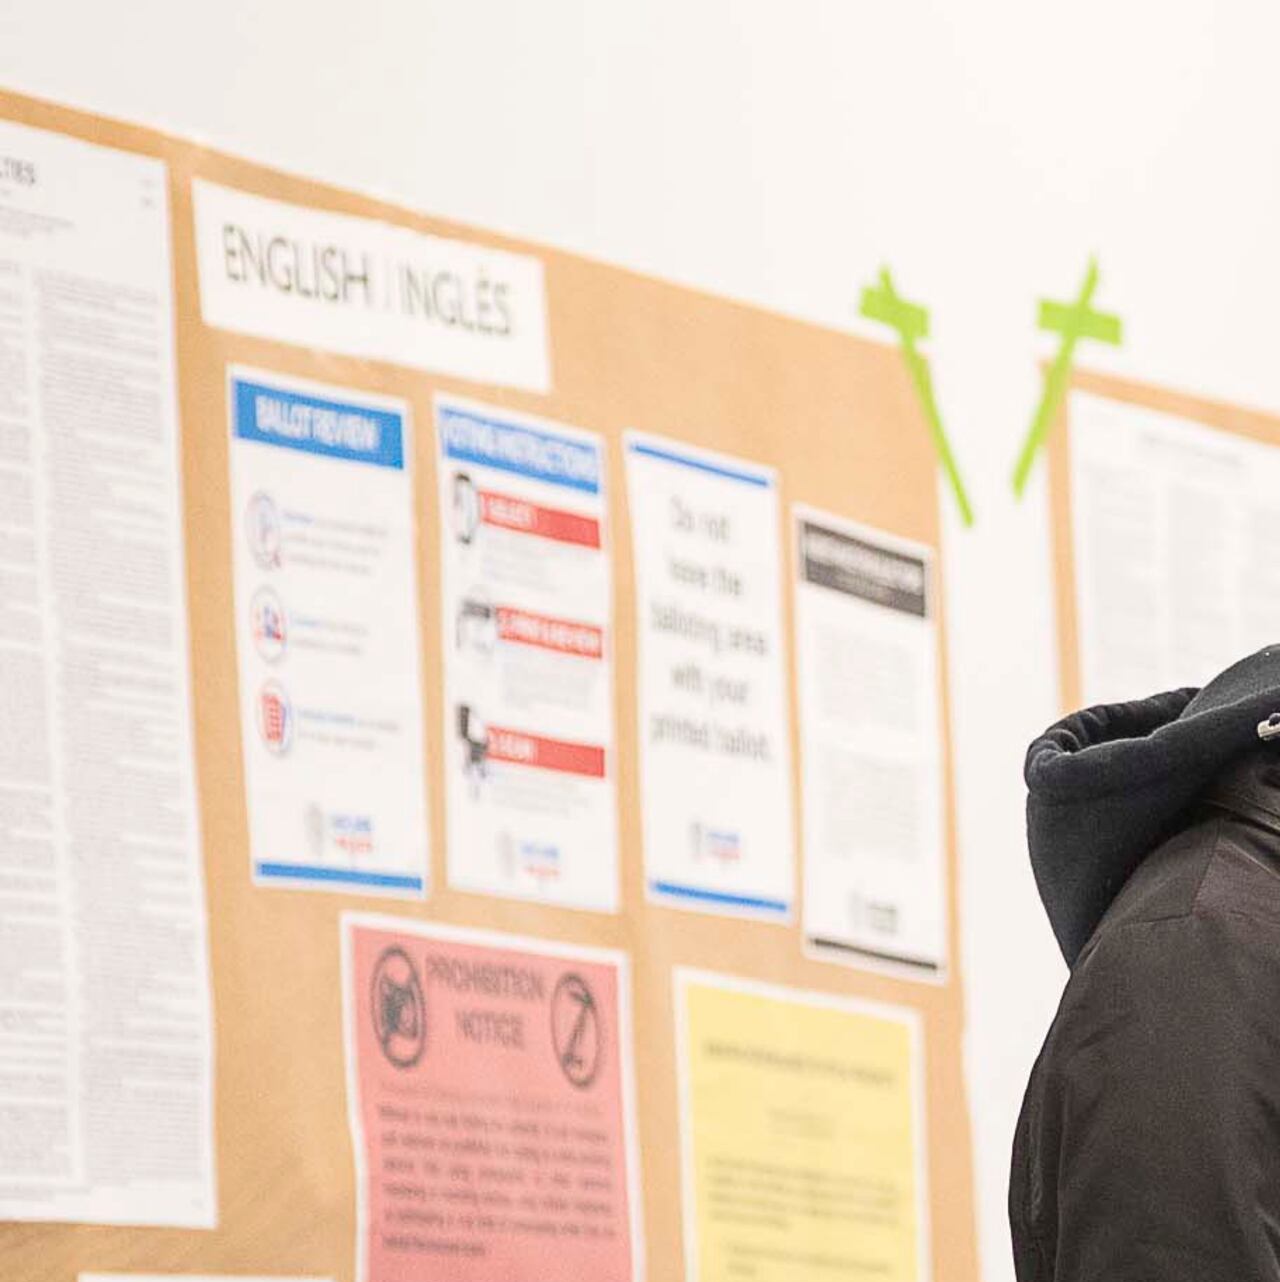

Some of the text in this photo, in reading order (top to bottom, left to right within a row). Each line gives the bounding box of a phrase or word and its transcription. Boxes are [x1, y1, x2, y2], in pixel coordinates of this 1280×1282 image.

[223, 224, 370, 307] ENGLISH
[402, 261, 512, 335] INGLÉS
[425, 954, 545, 1000] PROHIBITION
[456, 1008, 525, 1050] NOTICE
